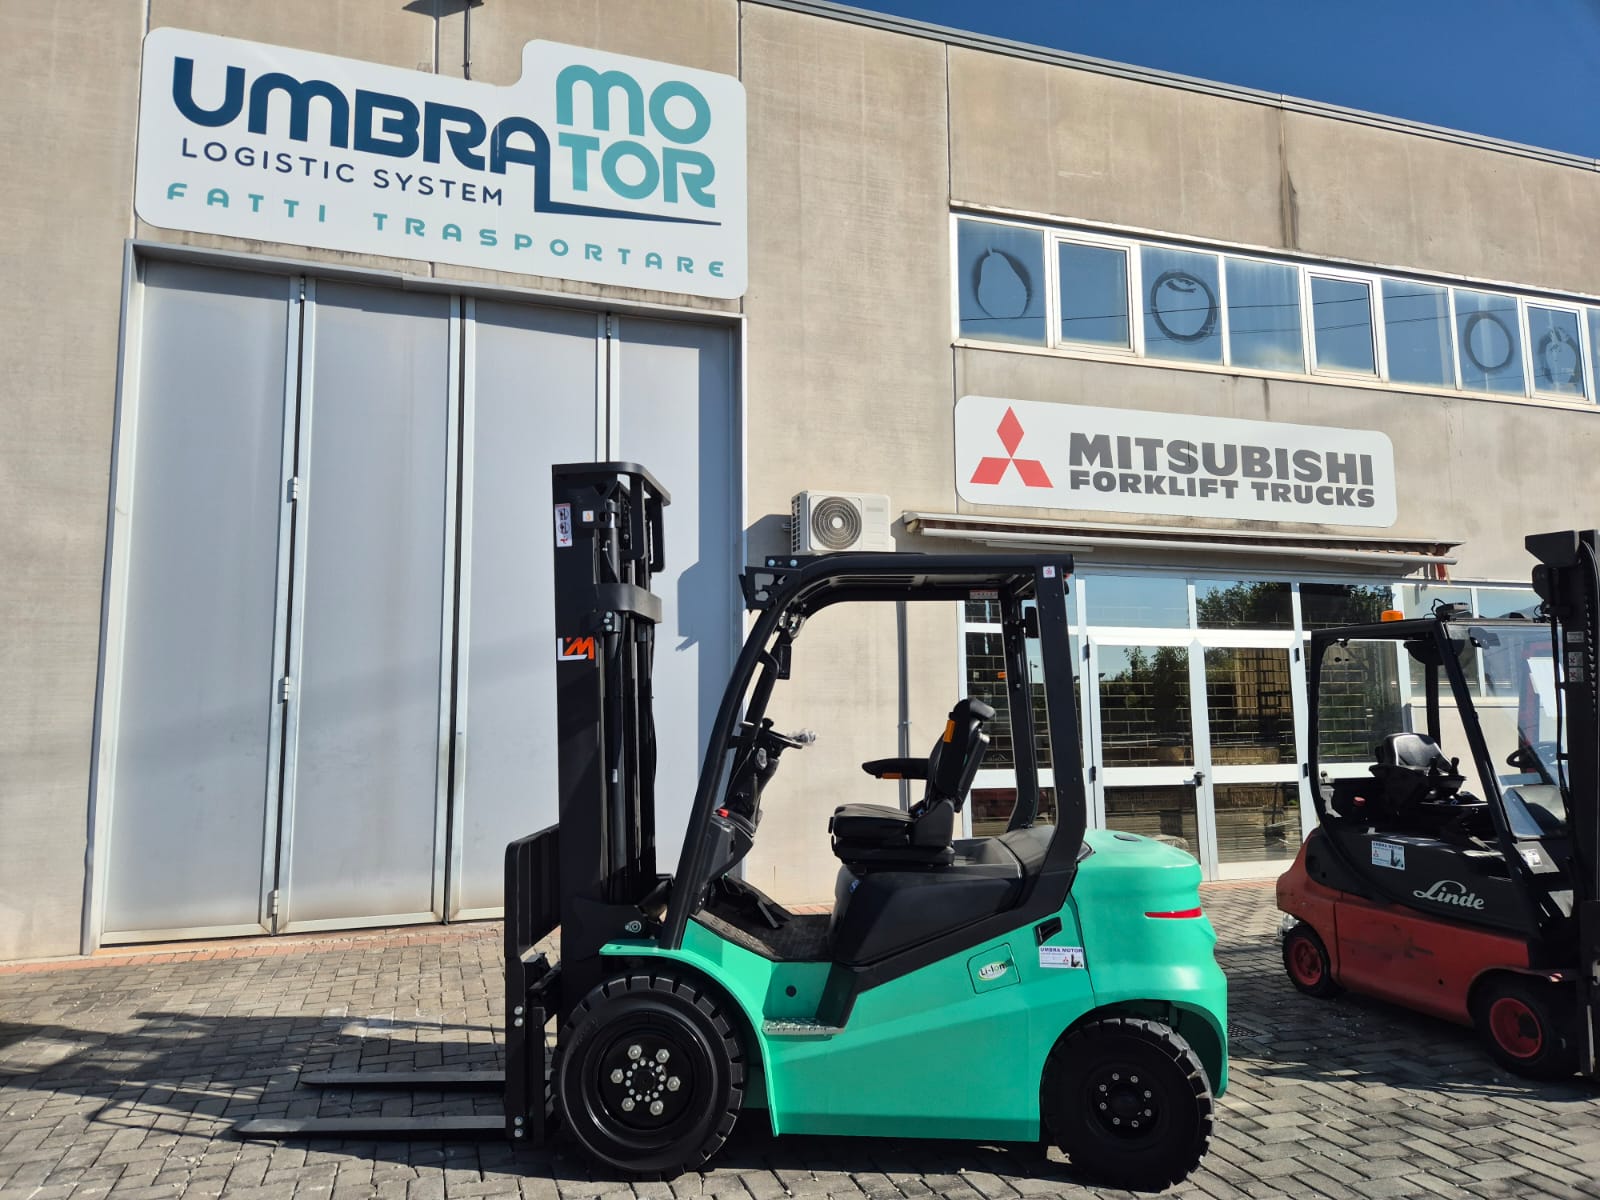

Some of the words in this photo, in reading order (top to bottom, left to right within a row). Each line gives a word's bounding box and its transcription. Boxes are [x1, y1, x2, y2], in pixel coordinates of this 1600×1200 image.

[171, 56, 552, 212] UMBRA
[555, 65, 712, 144] MO
[181, 137, 354, 183] LOGISTIC
[373, 168, 503, 206] SYSTEM
[558, 131, 716, 208] TOR
[167, 182, 327, 222] FATTI
[373, 212, 724, 278] TRASPORTARE
[1069, 432, 1374, 486] MITSUBISHI
[1070, 469, 1239, 499] FORKLIFT
[1250, 481, 1375, 508] TRUCKS
[1413, 880, 1485, 910] Linde
